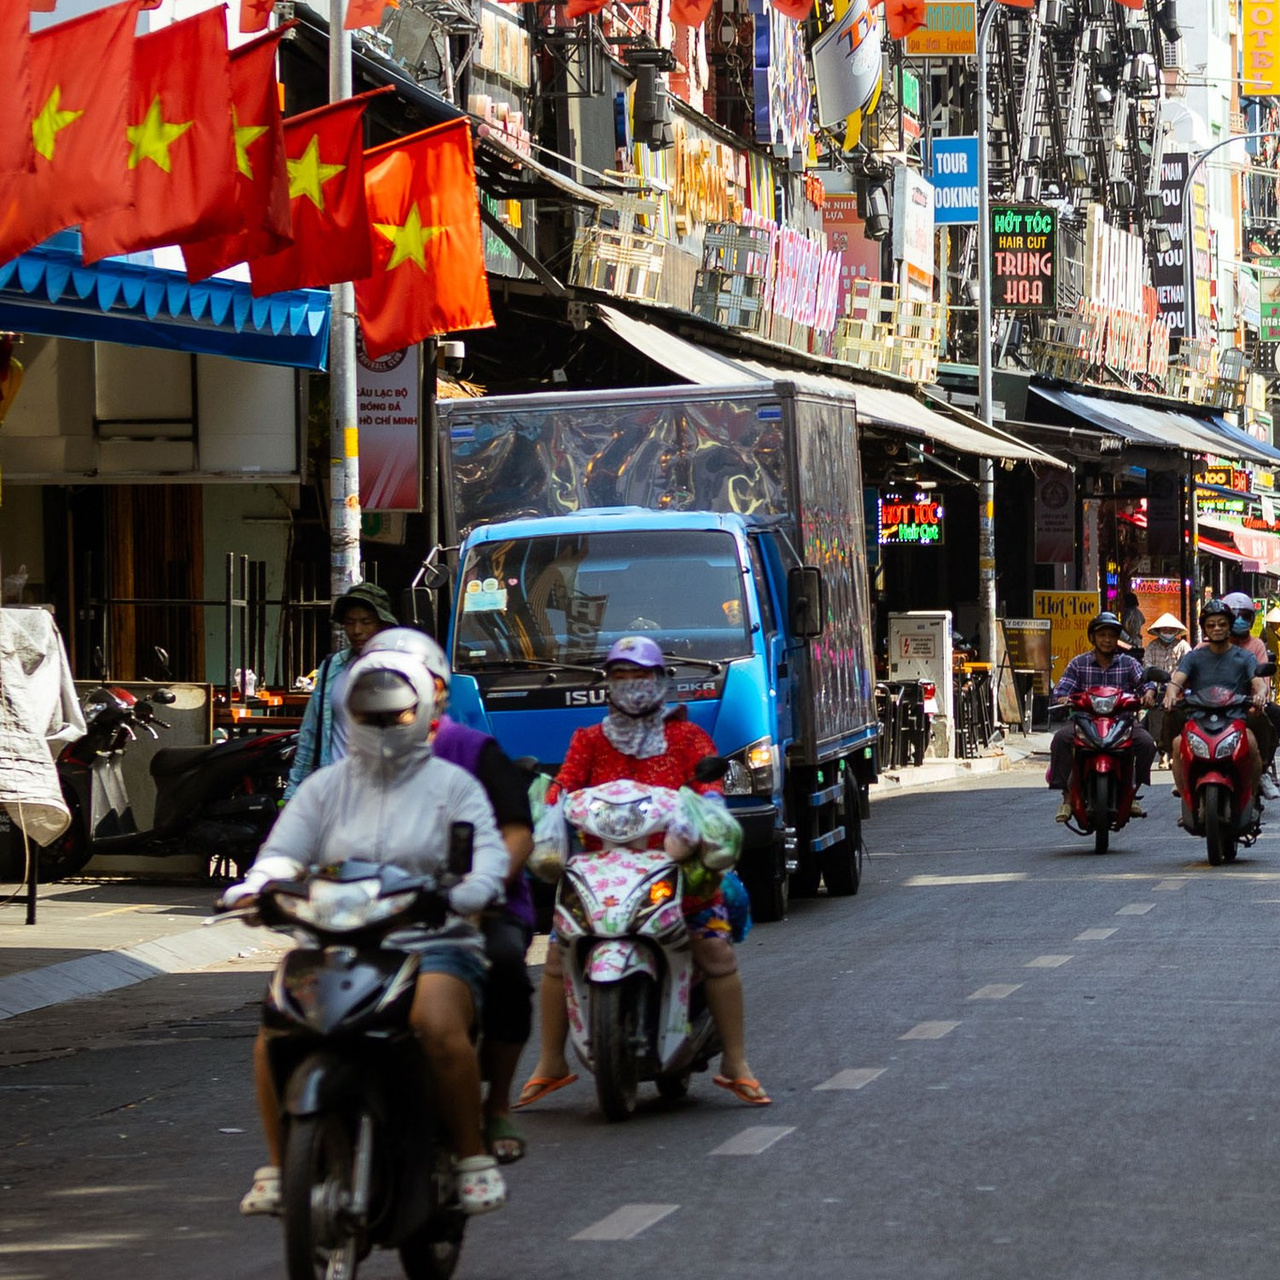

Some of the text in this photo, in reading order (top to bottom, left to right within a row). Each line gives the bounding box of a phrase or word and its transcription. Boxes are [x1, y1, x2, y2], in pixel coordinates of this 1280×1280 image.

[918, 6, 973, 31] MBOO
[936, 152, 967, 174] TOUR
[833, 200, 857, 210] NHIÊ
[935, 186, 979, 208] OOKING
[995, 210, 1052, 233] HỚT TÓC
[999, 236, 1047, 248] HAIR CUT
[994, 252, 1052, 277] TRUNG
[1003, 280, 1043, 304] HOA
[375, 388, 392, 399] LẠC
[360, 401, 401, 411] BÓNG ĐÁ
[375, 414, 391, 425] CHÍ
[393, 417, 417, 425] MINH
[899, 523, 919, 540] Hair
[565, 690, 606, 706] ISU
